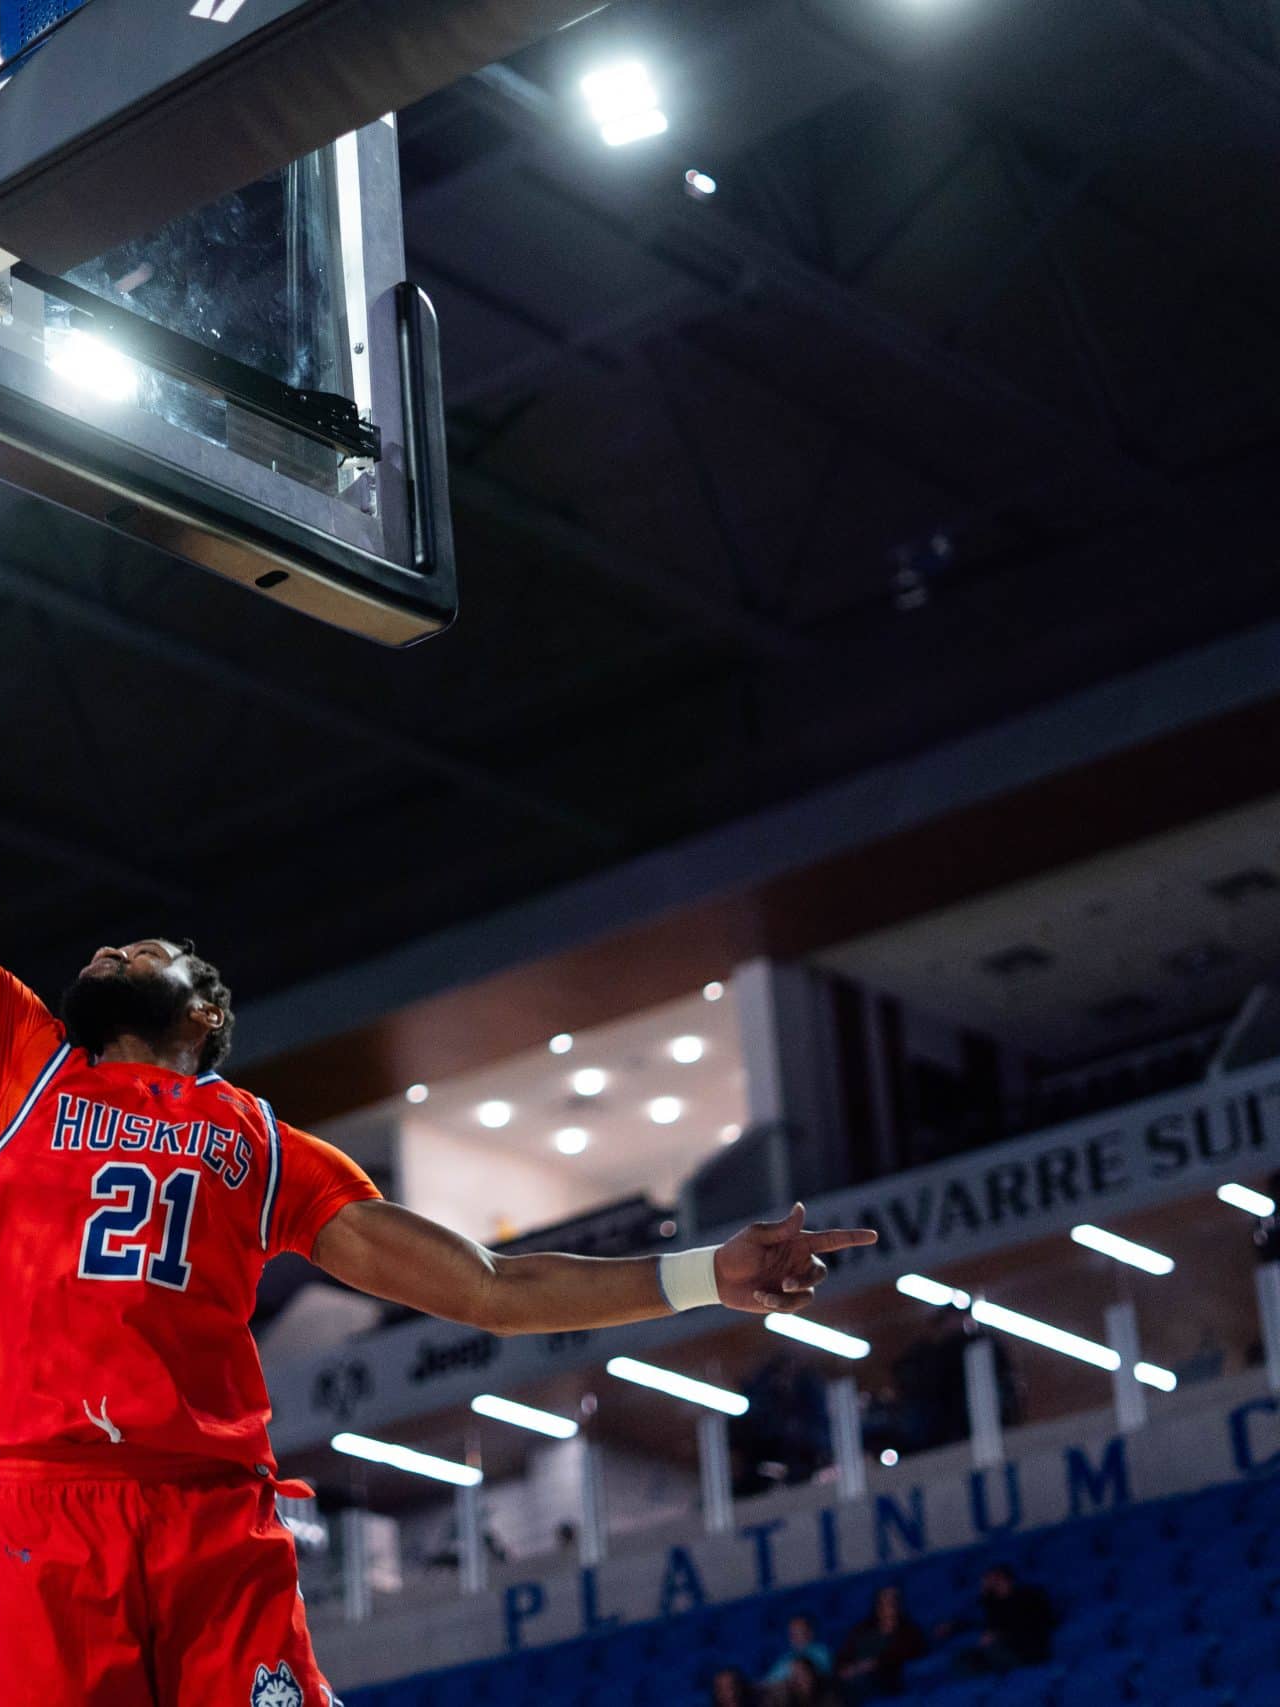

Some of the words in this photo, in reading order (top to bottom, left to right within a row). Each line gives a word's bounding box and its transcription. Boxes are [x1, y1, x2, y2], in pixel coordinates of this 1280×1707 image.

[51, 1093, 253, 1190] HUSKIES
[816, 1123, 1128, 1272] AVARRE
[77, 1161, 201, 1293] 21
[502, 1438, 1131, 1652] PLATINUM
